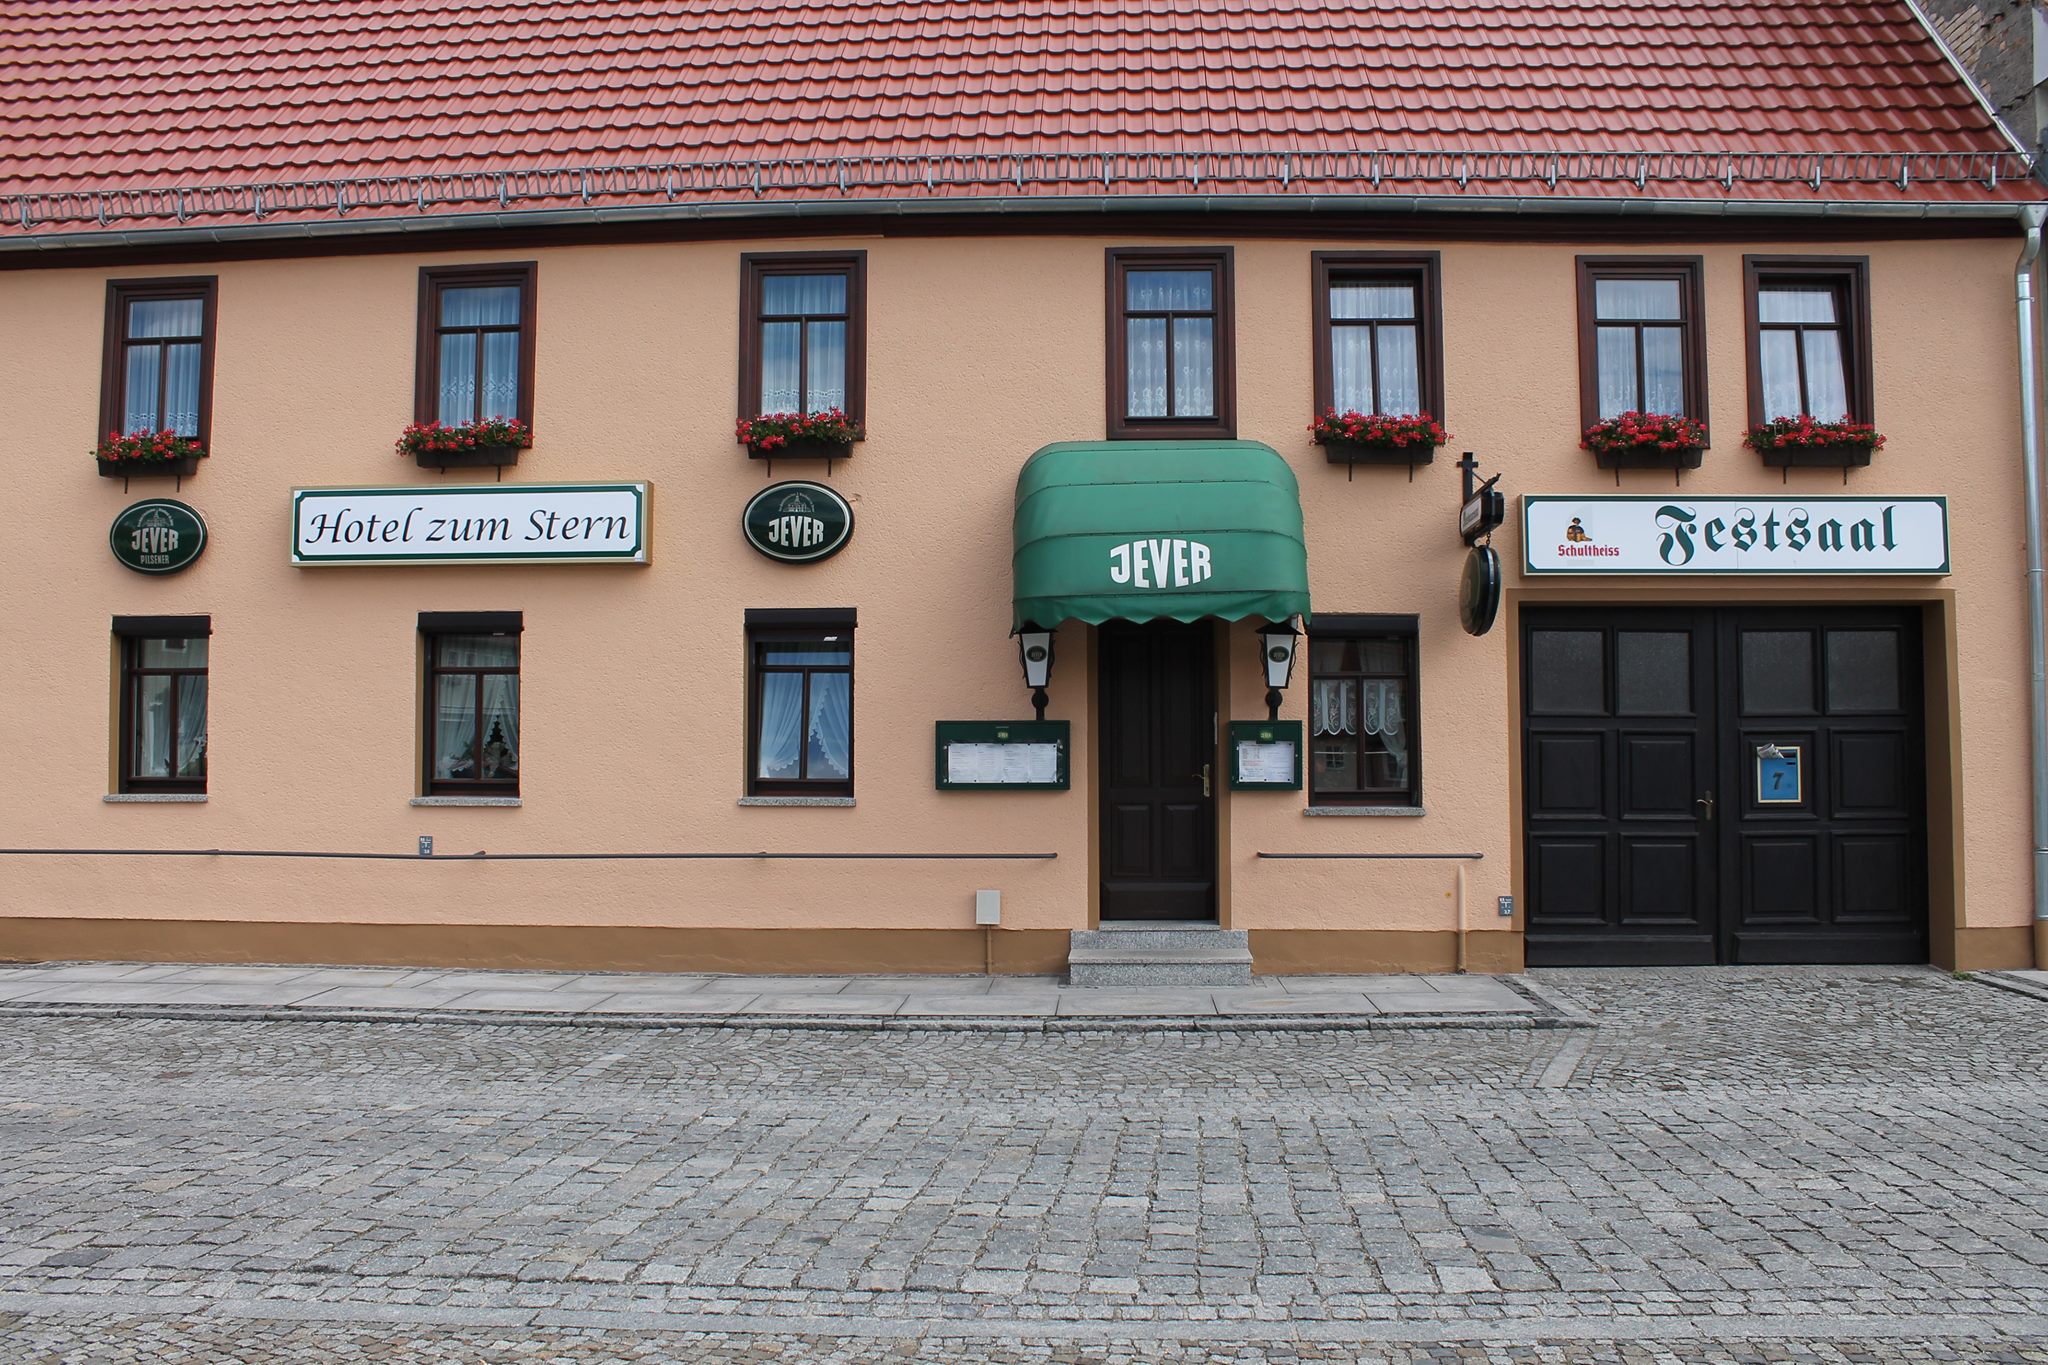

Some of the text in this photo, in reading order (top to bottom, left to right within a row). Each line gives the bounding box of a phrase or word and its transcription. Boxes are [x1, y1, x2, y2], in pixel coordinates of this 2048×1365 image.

[305, 507, 630, 543] Hotel zum Stern
[768, 515, 824, 547] JEVER
[1654, 504, 1899, 566] Festsaal
[131, 527, 179, 553] JEVER
[1557, 544, 1620, 558] Schultheiss
[140, 554, 170, 565] PILSENER
[1110, 539, 1212, 589] JEVER
[1773, 771, 1785, 790] 7
